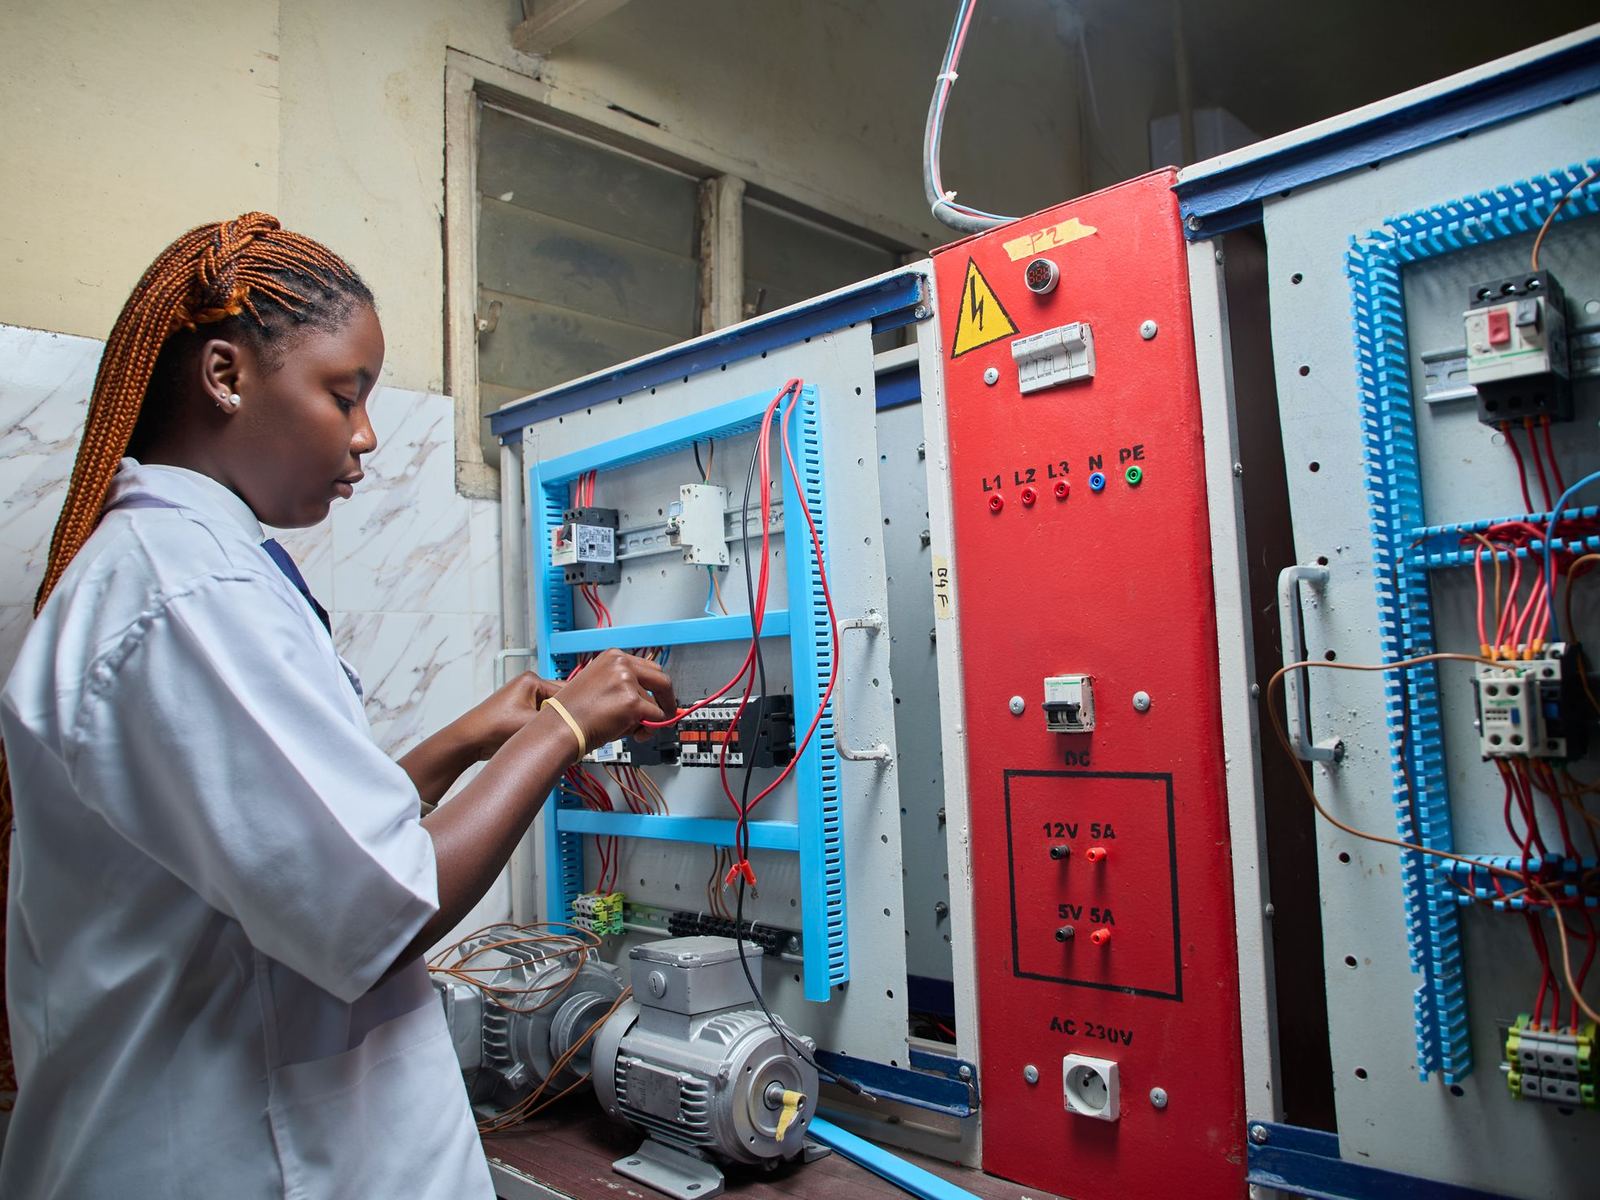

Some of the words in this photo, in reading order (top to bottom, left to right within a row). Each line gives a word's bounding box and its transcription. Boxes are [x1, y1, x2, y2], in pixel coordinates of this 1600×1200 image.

[982, 475, 1002, 492] L1
[1014, 468, 1036, 486] L2
[1047, 461, 1070, 479] L3
[1088, 454, 1103, 471] N
[1119, 444, 1146, 464] PE
[1065, 751, 1091, 768] DC
[1043, 822, 1078, 839] 12V
[1090, 823, 1116, 840] 5A
[1058, 903, 1082, 920] 5V
[1089, 907, 1116, 926] 5A
[1050, 1017, 1076, 1036] AC
[1084, 1021, 1133, 1047] 230V
